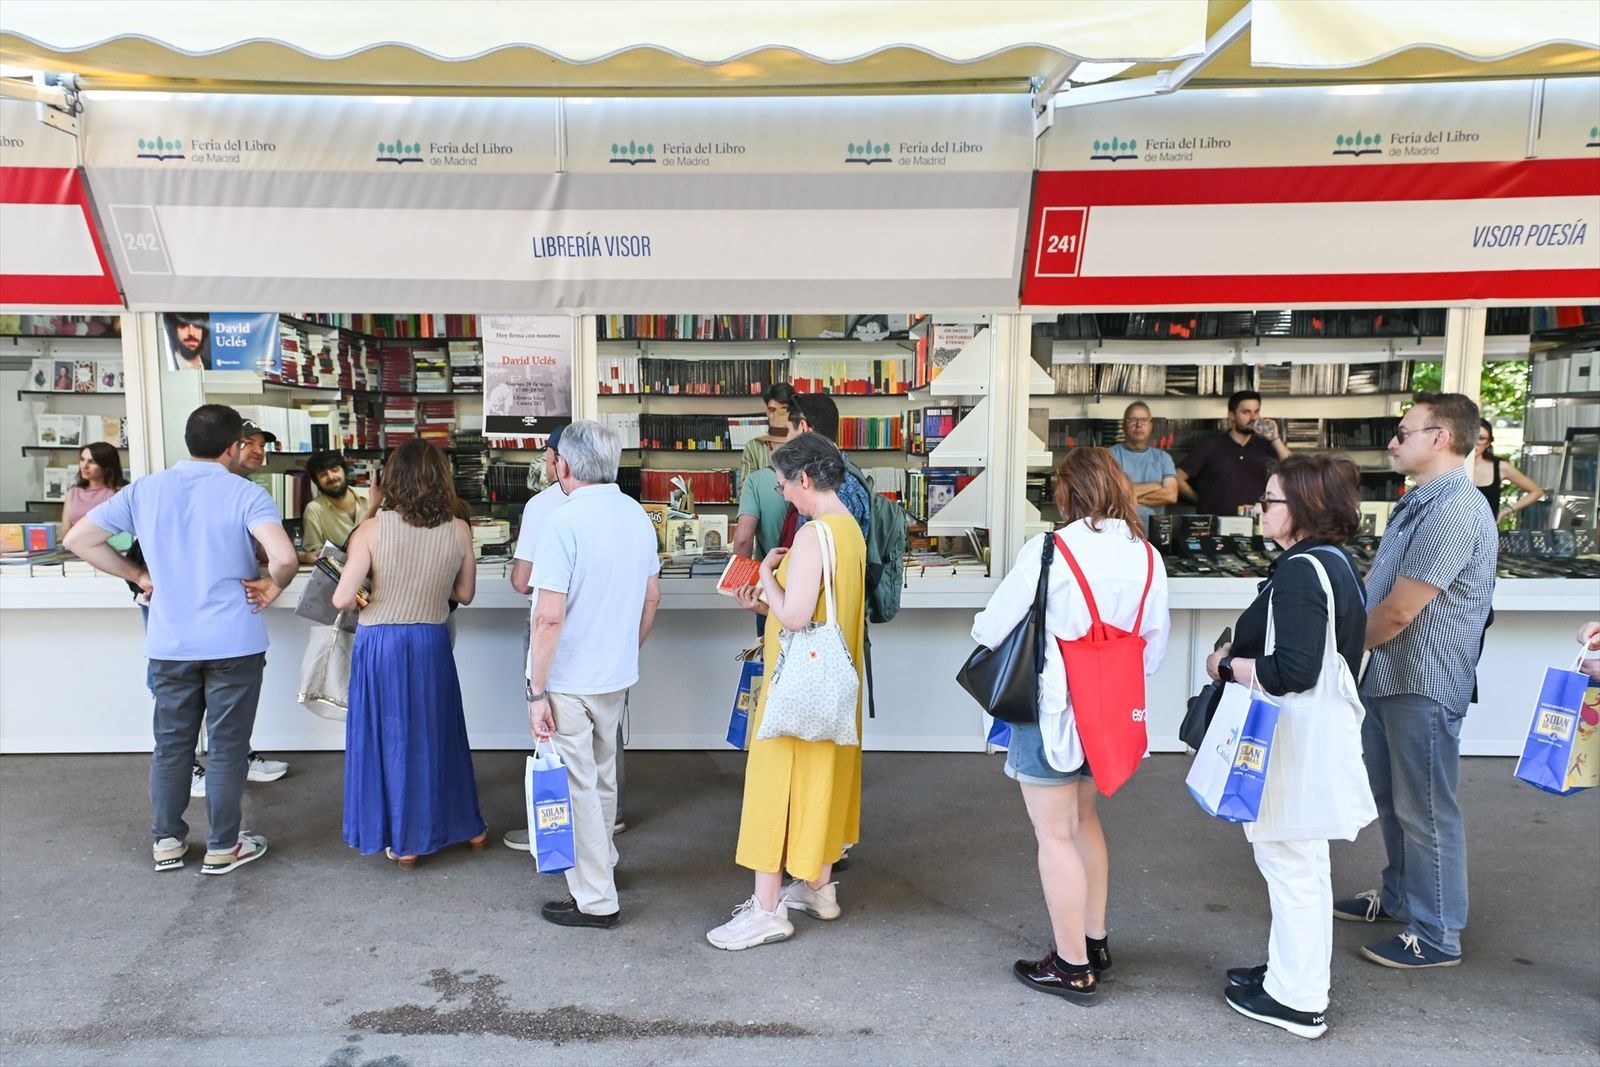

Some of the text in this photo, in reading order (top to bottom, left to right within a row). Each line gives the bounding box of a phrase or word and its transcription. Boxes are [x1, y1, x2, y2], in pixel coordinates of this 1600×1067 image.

[1390, 130, 1480, 144] Feria del Libro
[191, 139, 276, 151] Feria del Libro
[430, 142, 513, 154] Feria del Libro
[662, 142, 746, 154] Feria del Libro
[899, 142, 983, 153] Feria del Libro
[1145, 137, 1231, 150] Feria del Libro
[1144, 152, 1193, 162] de Madrid
[1388, 146, 1440, 156] de Madrid
[191, 153, 240, 163] de Madrid
[429, 156, 478, 166] de Madrid
[662, 156, 710, 166] de Madrid
[898, 156, 946, 165] de Madrid
[1472, 218, 1587, 248] VISOR POESÍA
[124, 233, 159, 251] 242
[532, 231, 651, 258] LIBRERÍA VISOR
[1046, 234, 1077, 253] 241
[215, 322, 251, 334] David
[215, 335, 247, 347] Uclés
[502, 355, 557, 365] David Uclés
[541, 806, 565, 817] SOLAN
